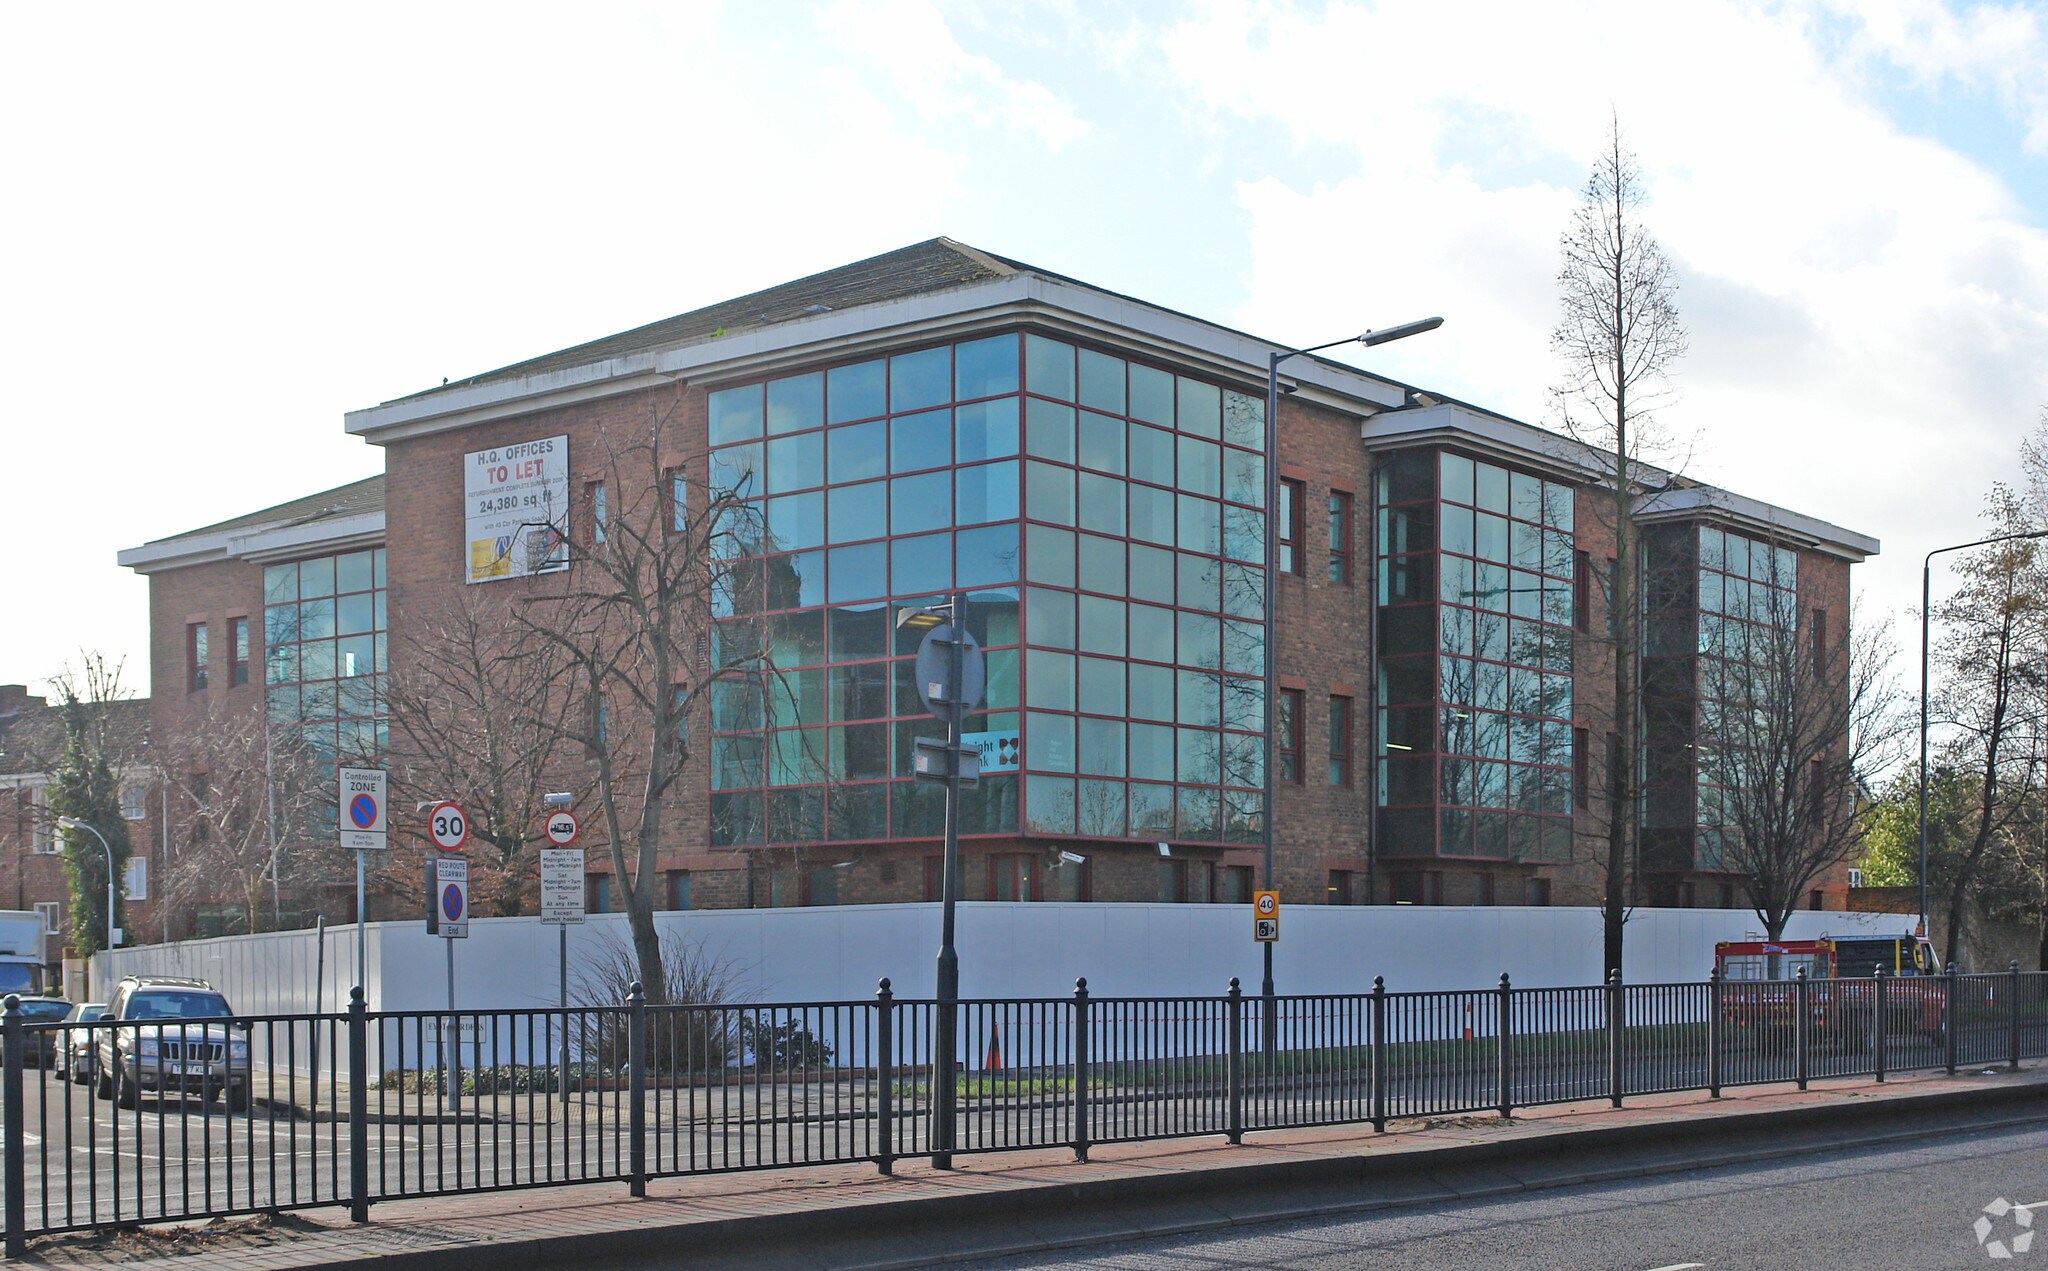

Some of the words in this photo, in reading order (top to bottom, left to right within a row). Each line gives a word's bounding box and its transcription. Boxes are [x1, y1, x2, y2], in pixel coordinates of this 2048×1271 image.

[478, 451, 500, 466] H.Q.
[506, 440, 553, 460] OFFICES
[487, 465, 508, 484] TO
[516, 458, 543, 480] LET
[480, 495, 518, 514] 24,380
[524, 494, 537, 508] sq
[543, 489, 552, 503] ft
[344, 771, 382, 782] Controlled
[350, 781, 376, 792] ZONE
[435, 816, 463, 836] 30
[438, 861, 448, 869] RED
[449, 861, 466, 870] ROUTE
[438, 869, 466, 878] CLEARWAY
[1260, 899, 1274, 909] 40
[448, 926, 459, 935] End
